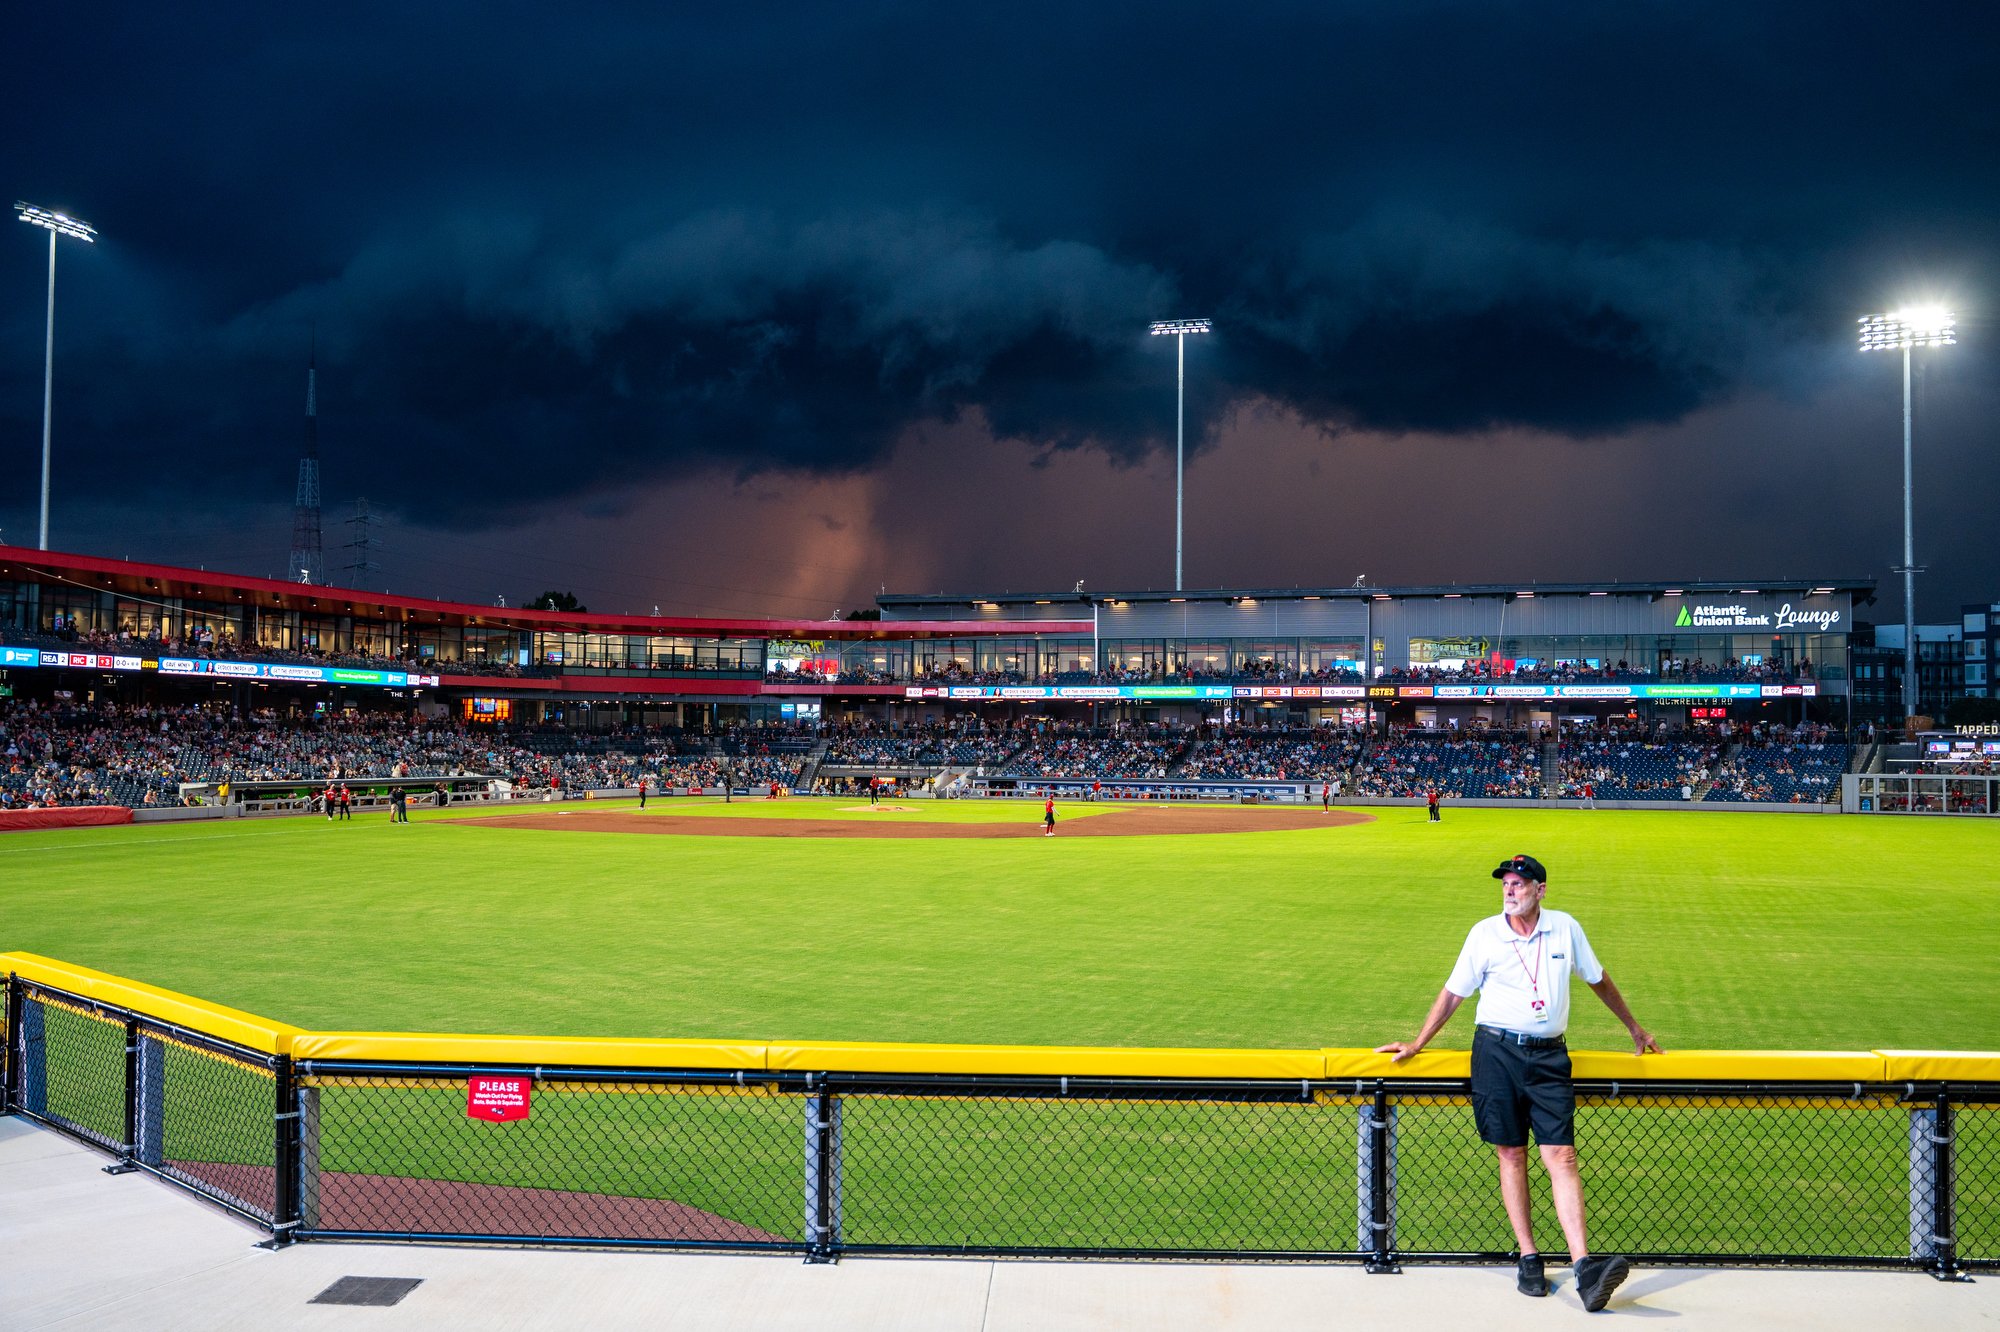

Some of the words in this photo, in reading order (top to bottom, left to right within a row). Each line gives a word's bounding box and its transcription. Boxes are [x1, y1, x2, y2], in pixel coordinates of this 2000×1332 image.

[1694, 605, 1747, 616] Atlantic
[1693, 616, 1733, 626] Union
[1735, 615, 1769, 626] Bank
[1774, 603, 1840, 631] Lounge
[42, 654, 57, 663] REA
[72, 656, 85, 664] RIC
[1369, 687, 1395, 696] ESTES
[1712, 697, 1733, 706] BRD
[1954, 725, 1999, 735] TAPPED
[479, 1081, 520, 1092] PLEASE
